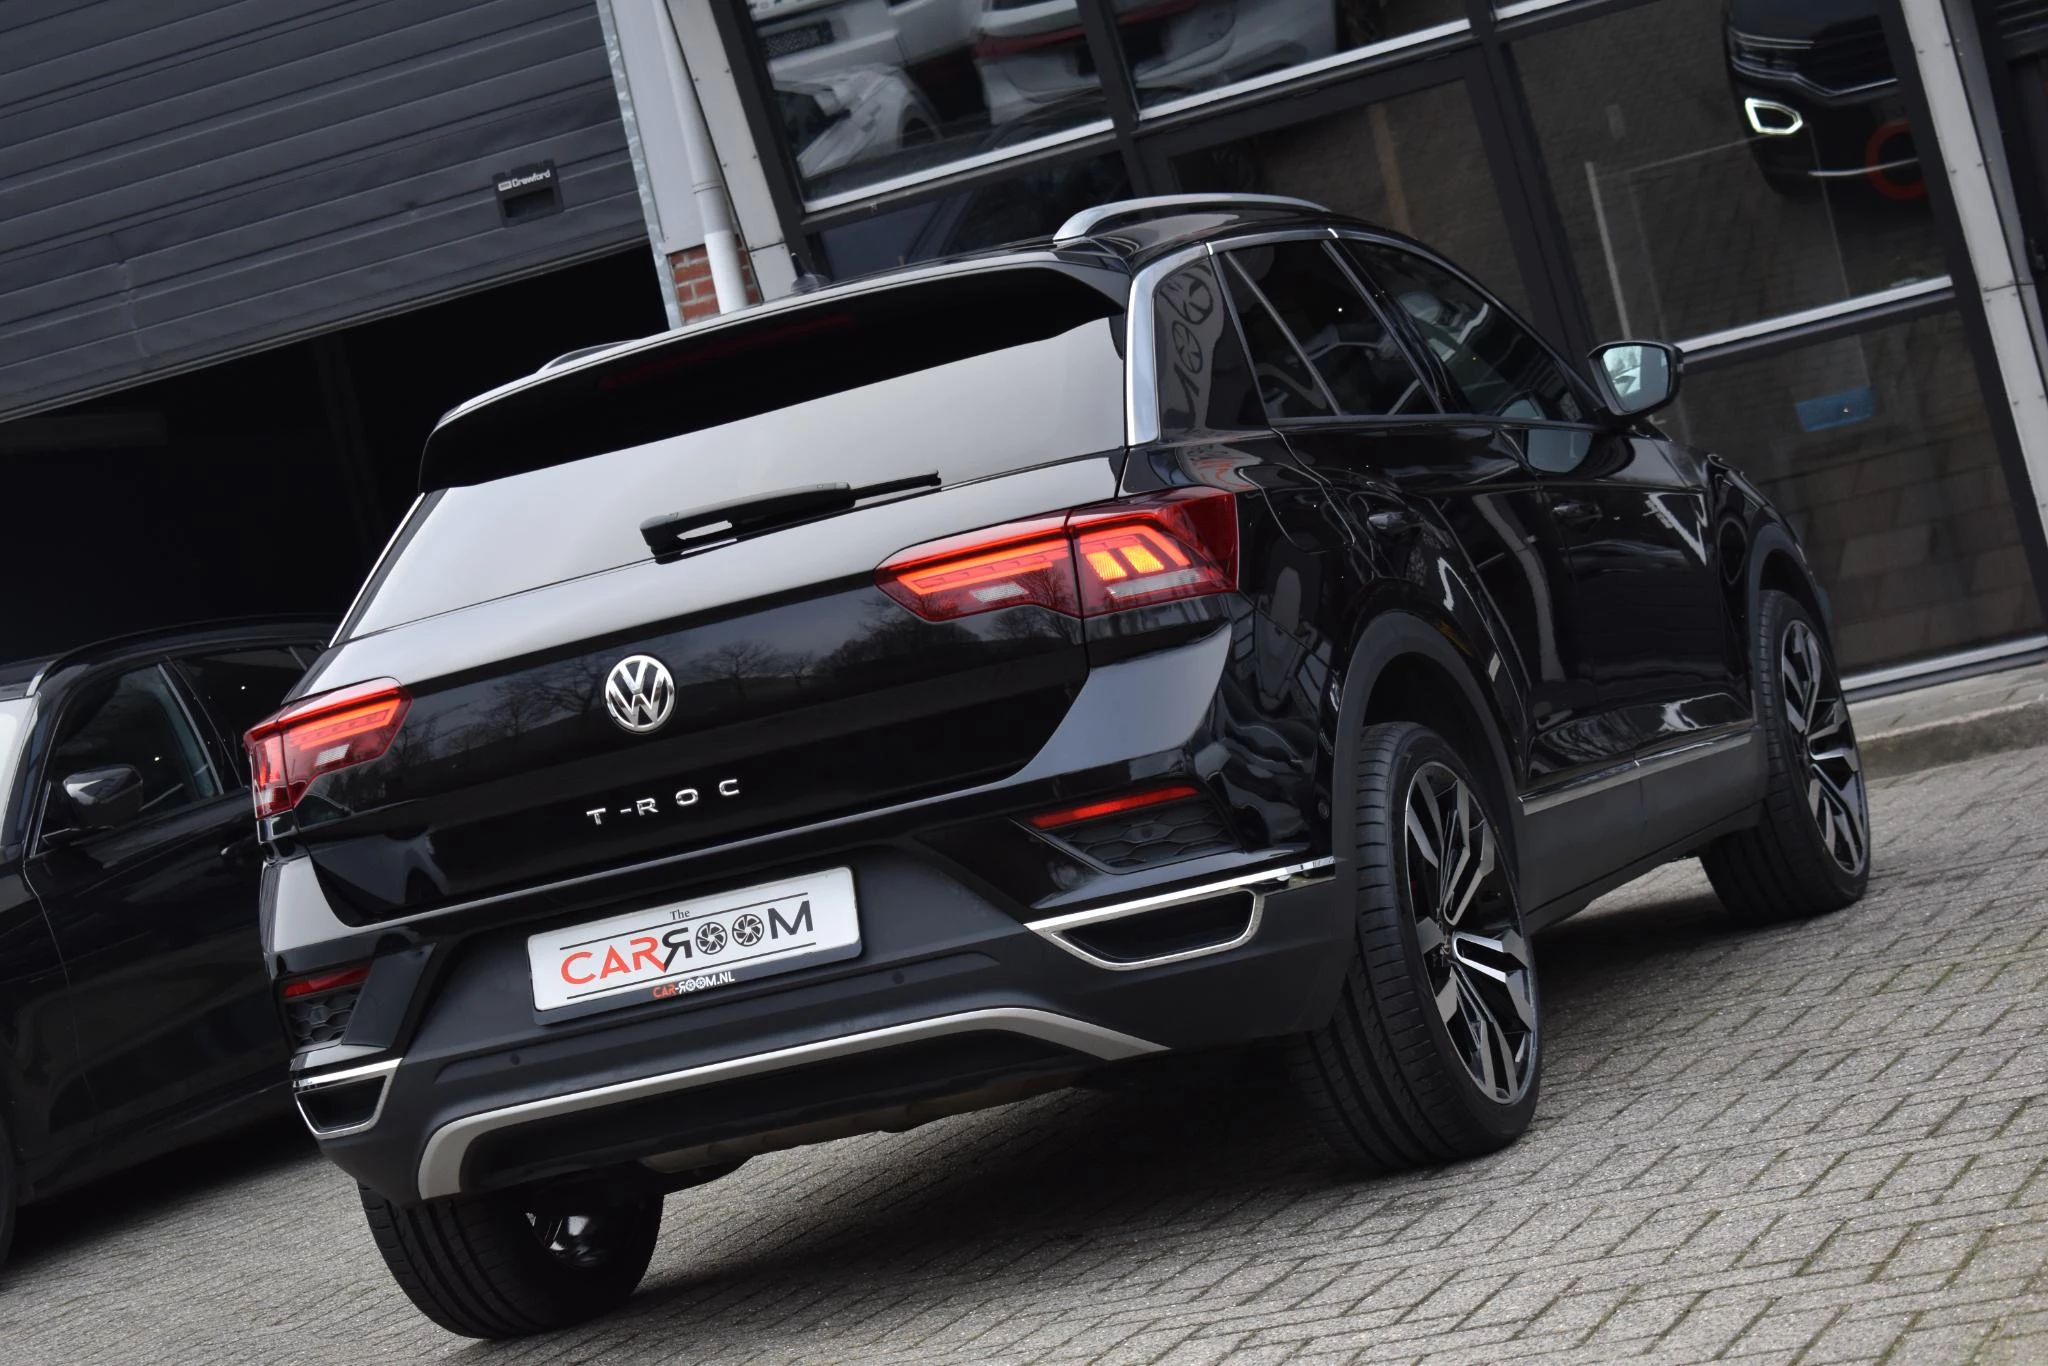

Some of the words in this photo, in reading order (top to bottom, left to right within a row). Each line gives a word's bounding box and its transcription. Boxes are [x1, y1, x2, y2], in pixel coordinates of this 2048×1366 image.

[605, 655, 675, 732] VW
[586, 778, 740, 825] T-ROC
[670, 907, 690, 921] The
